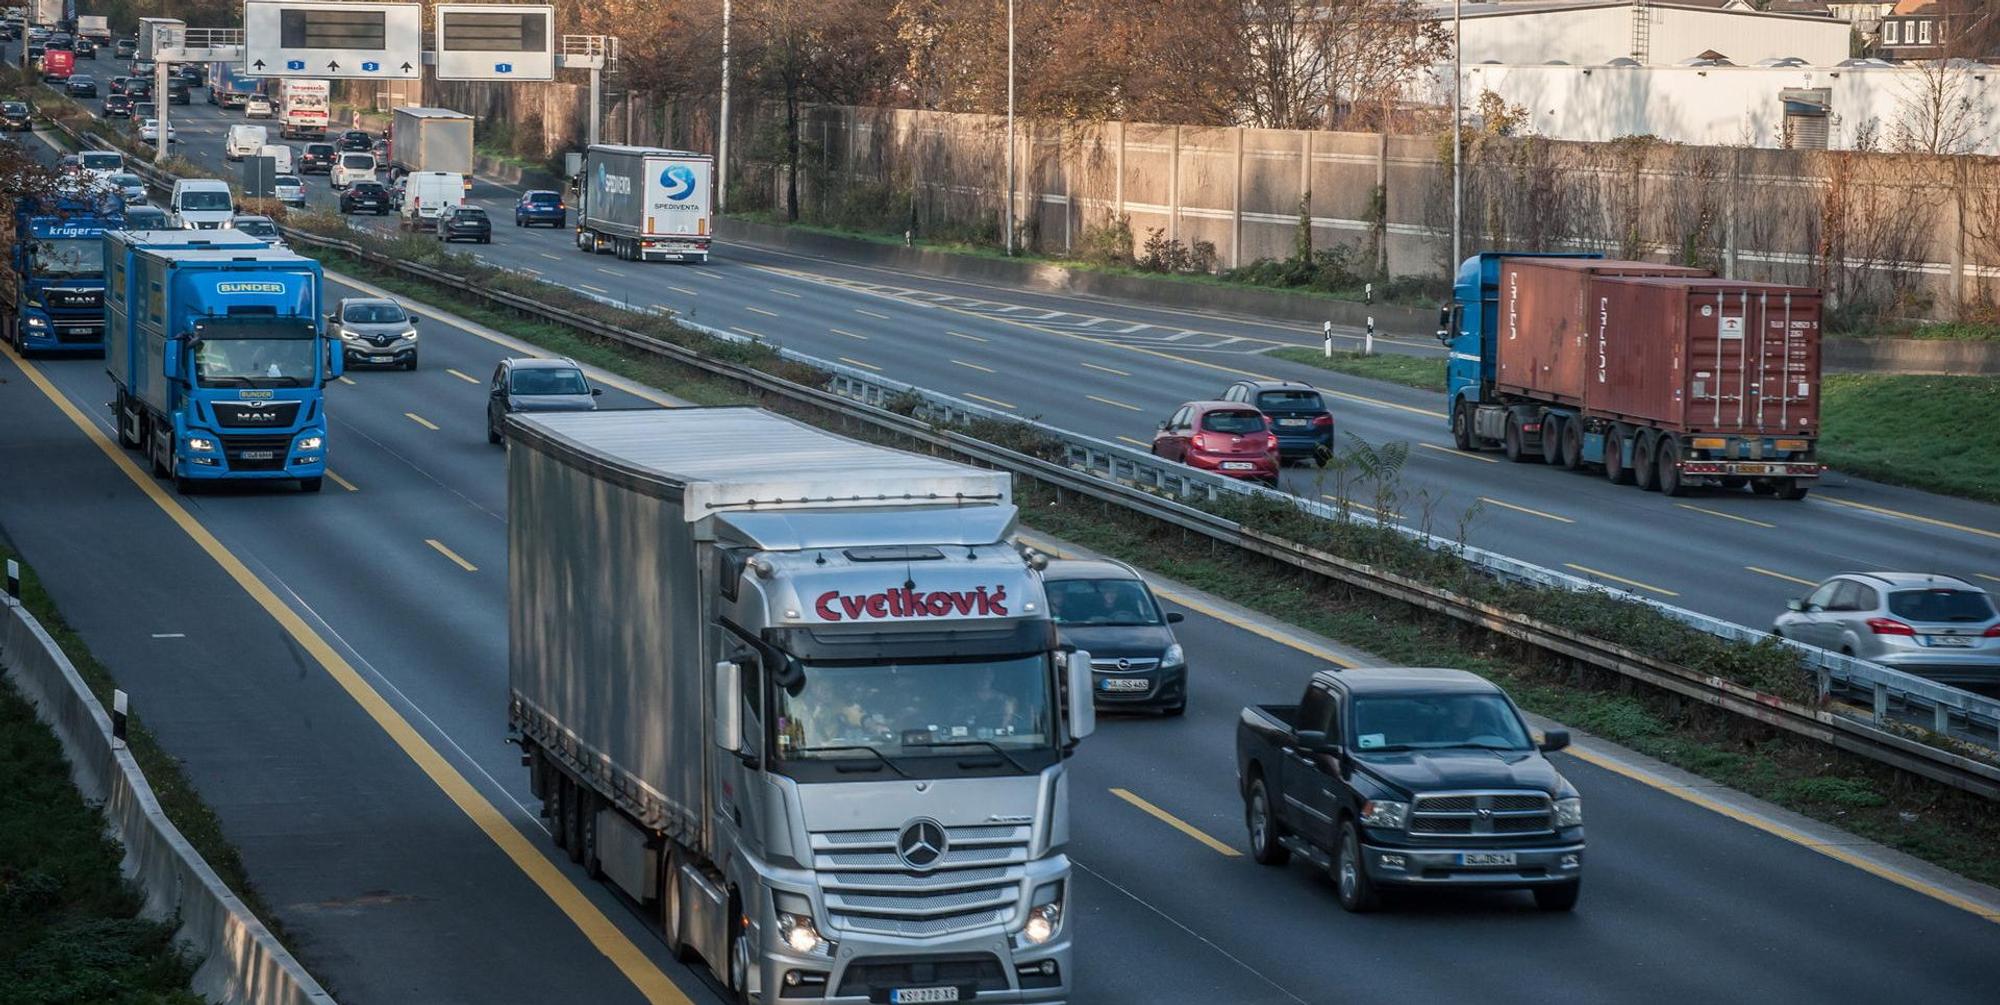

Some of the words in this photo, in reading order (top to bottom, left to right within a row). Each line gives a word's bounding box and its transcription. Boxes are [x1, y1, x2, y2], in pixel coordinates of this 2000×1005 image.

[654, 203, 700, 211] SPEDIVENTA
[220, 284, 281, 292] BUNDER
[64, 296, 96, 304] MAN
[237, 413, 276, 421] MAN
[900, 990, 913, 1002] NS
